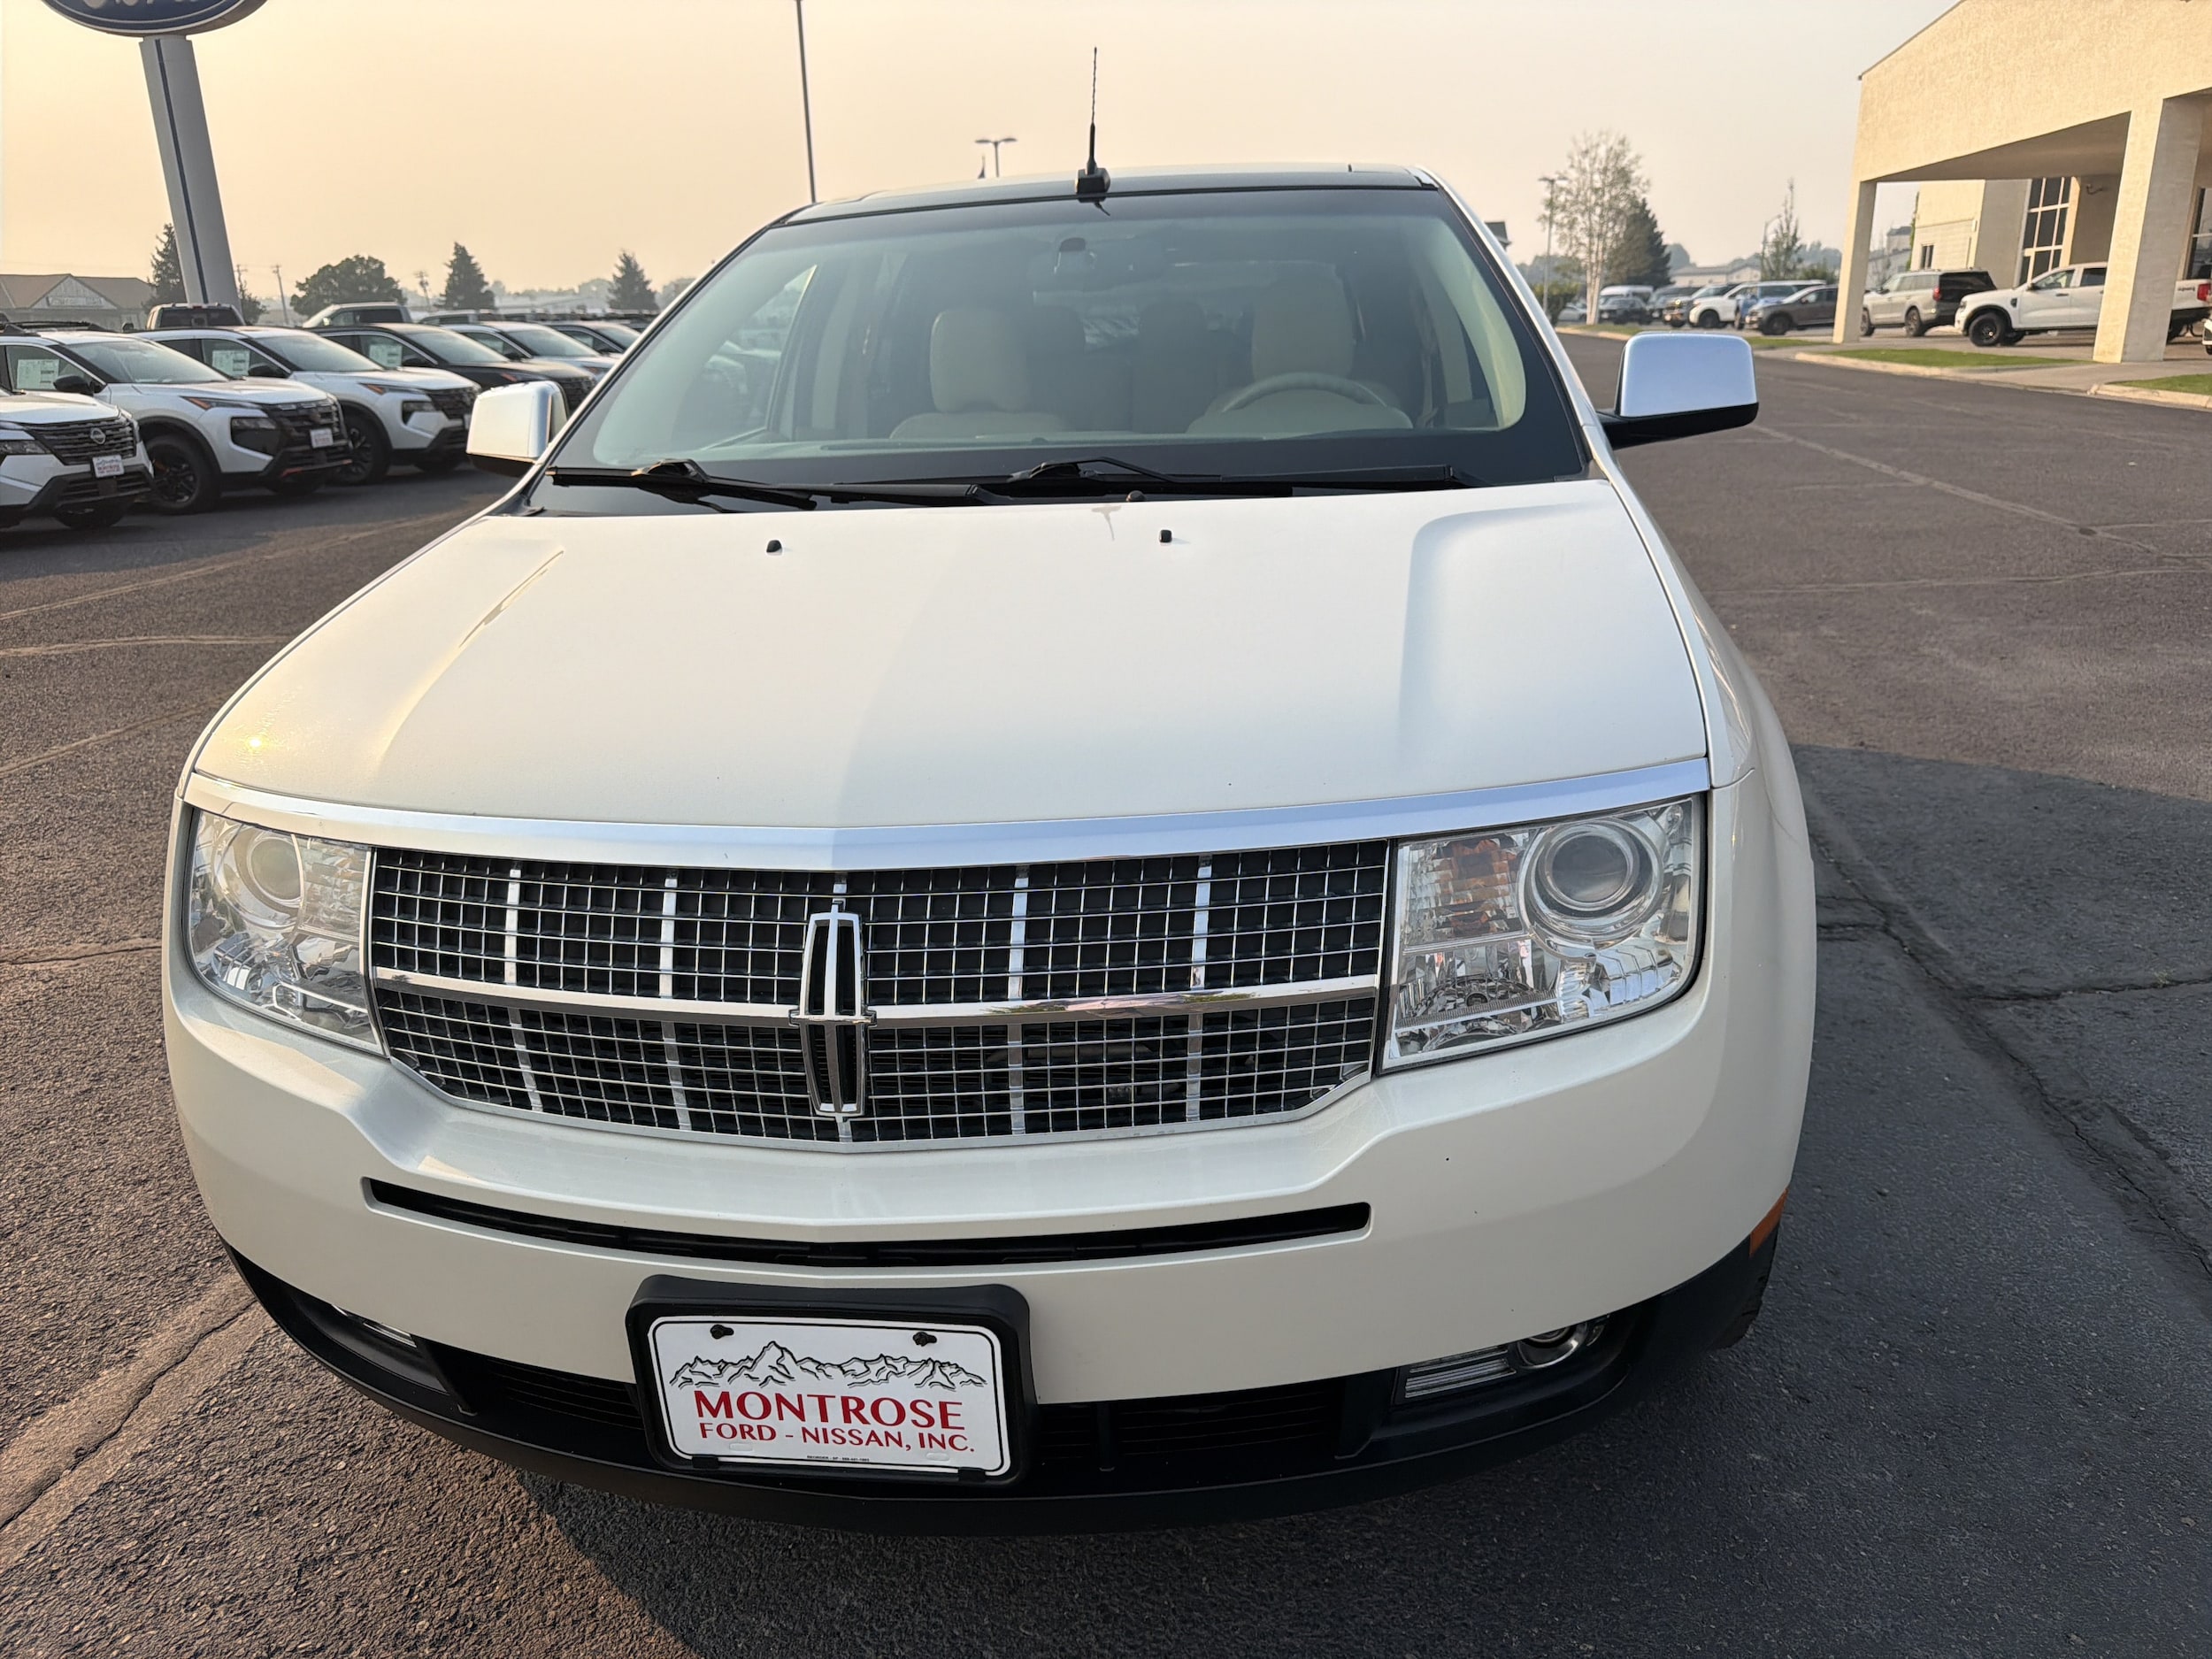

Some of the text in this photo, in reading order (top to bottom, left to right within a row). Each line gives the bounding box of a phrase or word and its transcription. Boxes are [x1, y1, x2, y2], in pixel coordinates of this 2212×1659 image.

[694, 1390, 965, 1430] MONTROSE
[700, 1422, 777, 1441] FORD
[802, 1427, 912, 1451] NISSAN,
[918, 1432, 976, 1453] INC.
